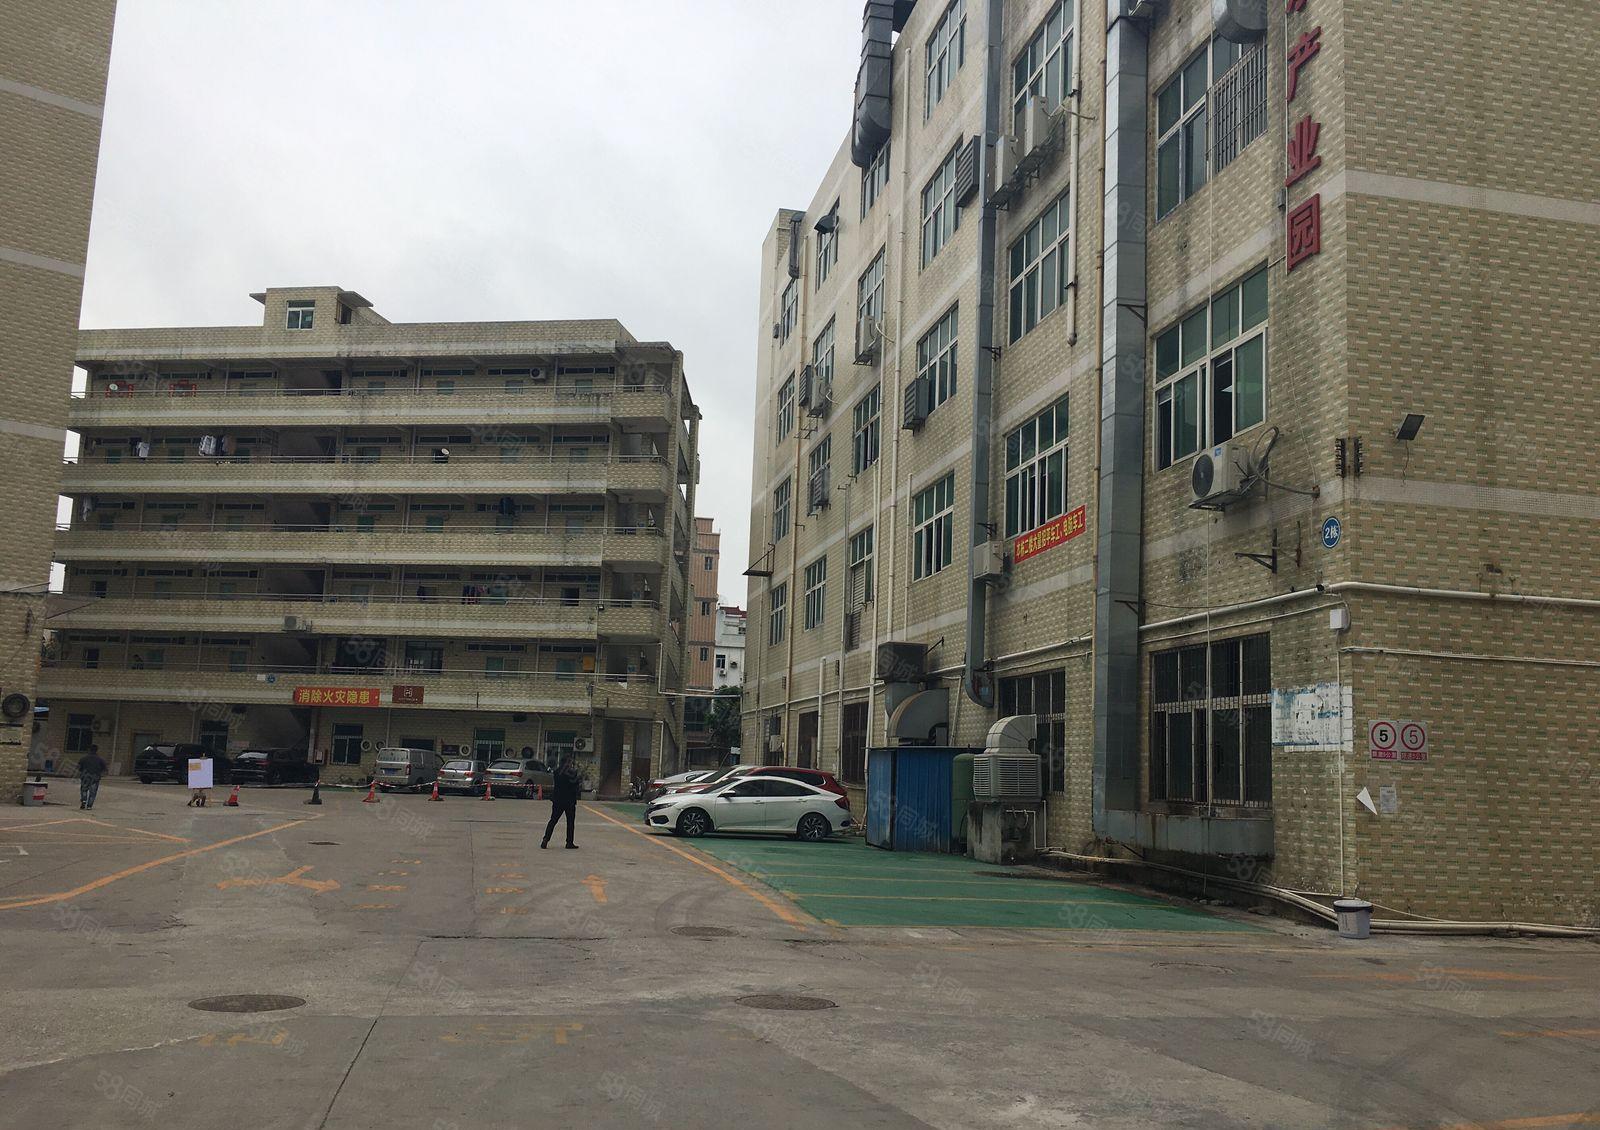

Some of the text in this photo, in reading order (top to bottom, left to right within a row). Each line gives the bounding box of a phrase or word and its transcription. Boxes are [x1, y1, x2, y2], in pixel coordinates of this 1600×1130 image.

[1325, 525, 1338, 540] 2栋
[298, 688, 371, 705] 消除火灾隐患
[1379, 729, 1389, 743] 5
[1409, 729, 1418, 745] 5
